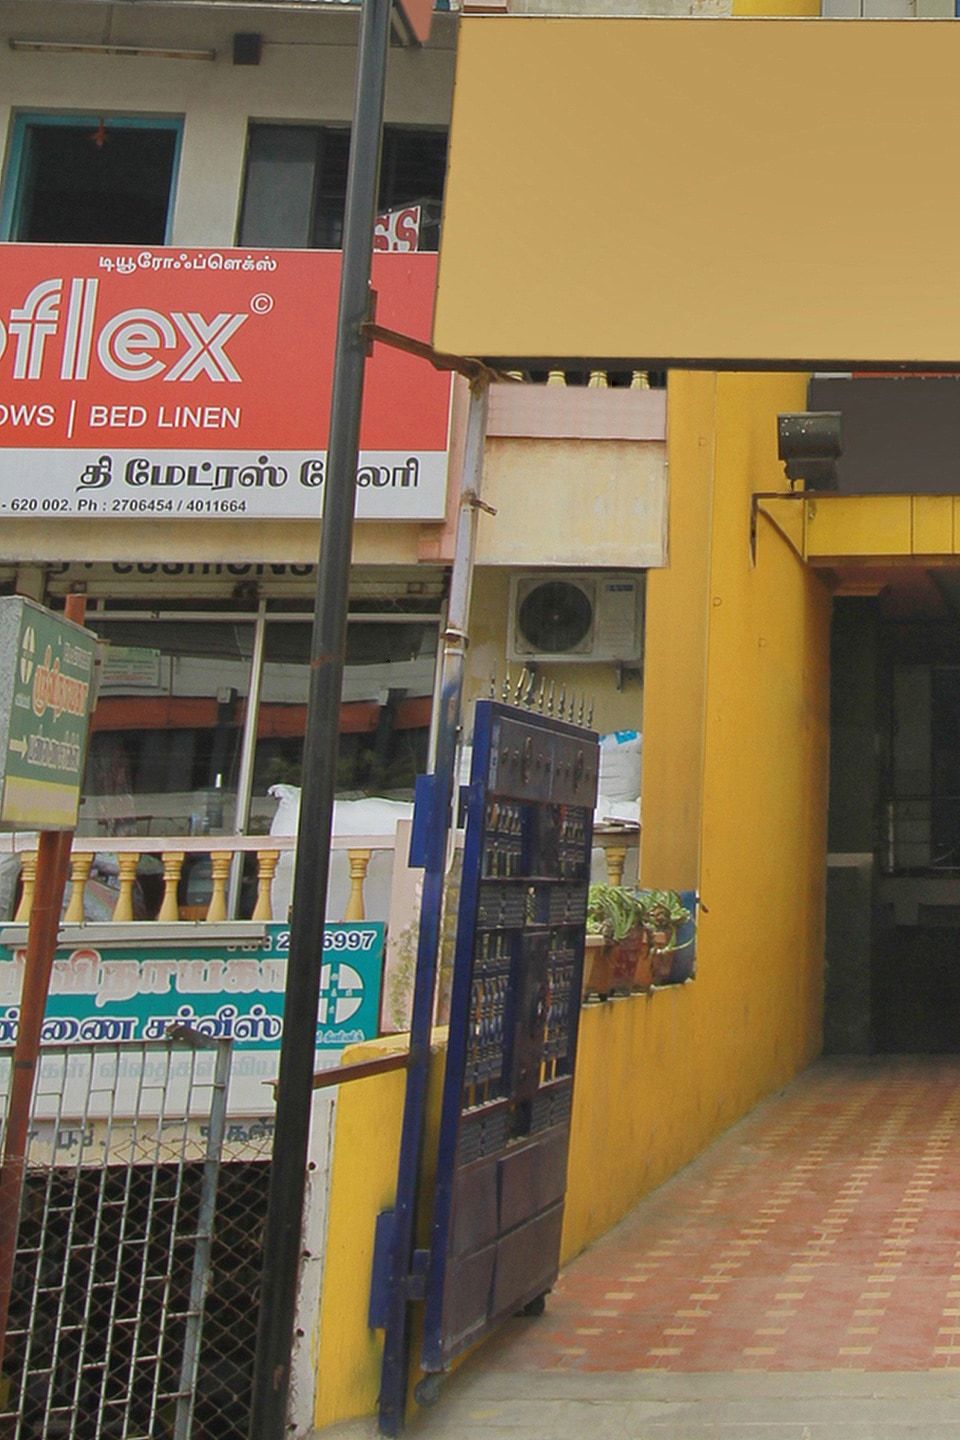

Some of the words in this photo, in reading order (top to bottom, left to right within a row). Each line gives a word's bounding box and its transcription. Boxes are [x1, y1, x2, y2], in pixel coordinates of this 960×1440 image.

[0, 277, 249, 382] flex
[89, 406, 147, 428] BED
[157, 407, 241, 429] LINEN
[75, 455, 113, 493] தி
[124, 455, 288, 491] மேட்ரஸ்
[11, 499, 38, 511] 620
[42, 499, 72, 511] 002.
[77, 499, 98, 511] Ph
[112, 500, 173, 511] 2706454
[186, 500, 247, 512] 4011664
